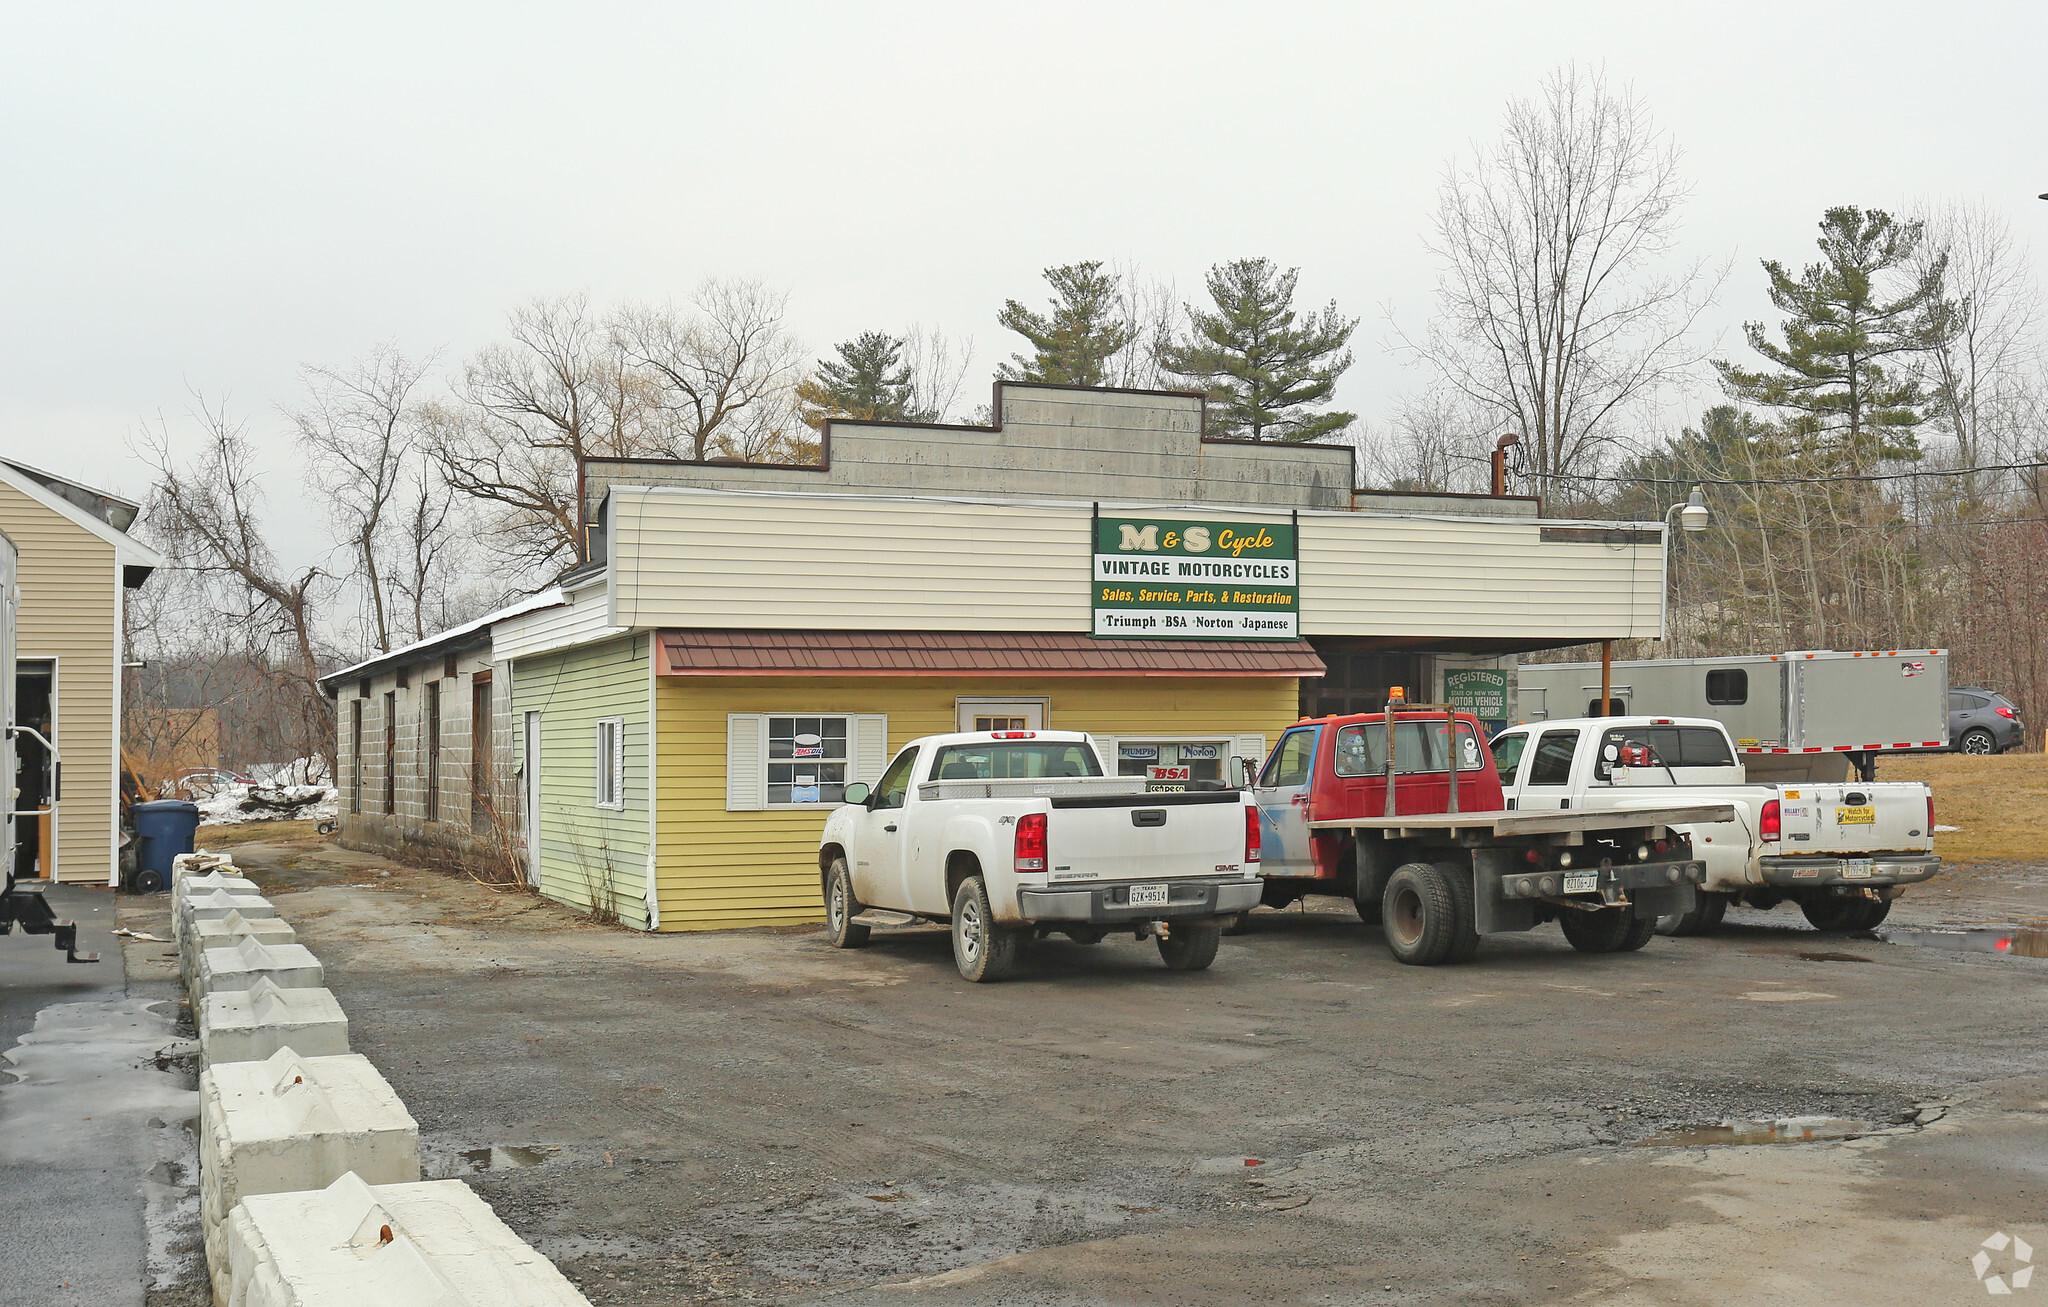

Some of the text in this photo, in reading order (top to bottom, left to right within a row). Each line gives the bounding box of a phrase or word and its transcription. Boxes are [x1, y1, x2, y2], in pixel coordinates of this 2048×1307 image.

[1118, 524, 1274, 557] M & S Cycle
[1102, 560, 1290, 579] VINTAGE MOTORCYCLES
[1101, 588, 1292, 605] Sales, Service, Parts, & Restoration
[1447, 671, 1504, 687] REGISTERED
[1448, 696, 1503, 706] MOTOR VEHICLE
[1480, 706, 1500, 717] SHOP
[794, 748, 823, 756] AMSOIL
[1183, 743, 1217, 758] Norton
[1154, 767, 1189, 779] BSA
[1215, 864, 1239, 872] GMC
